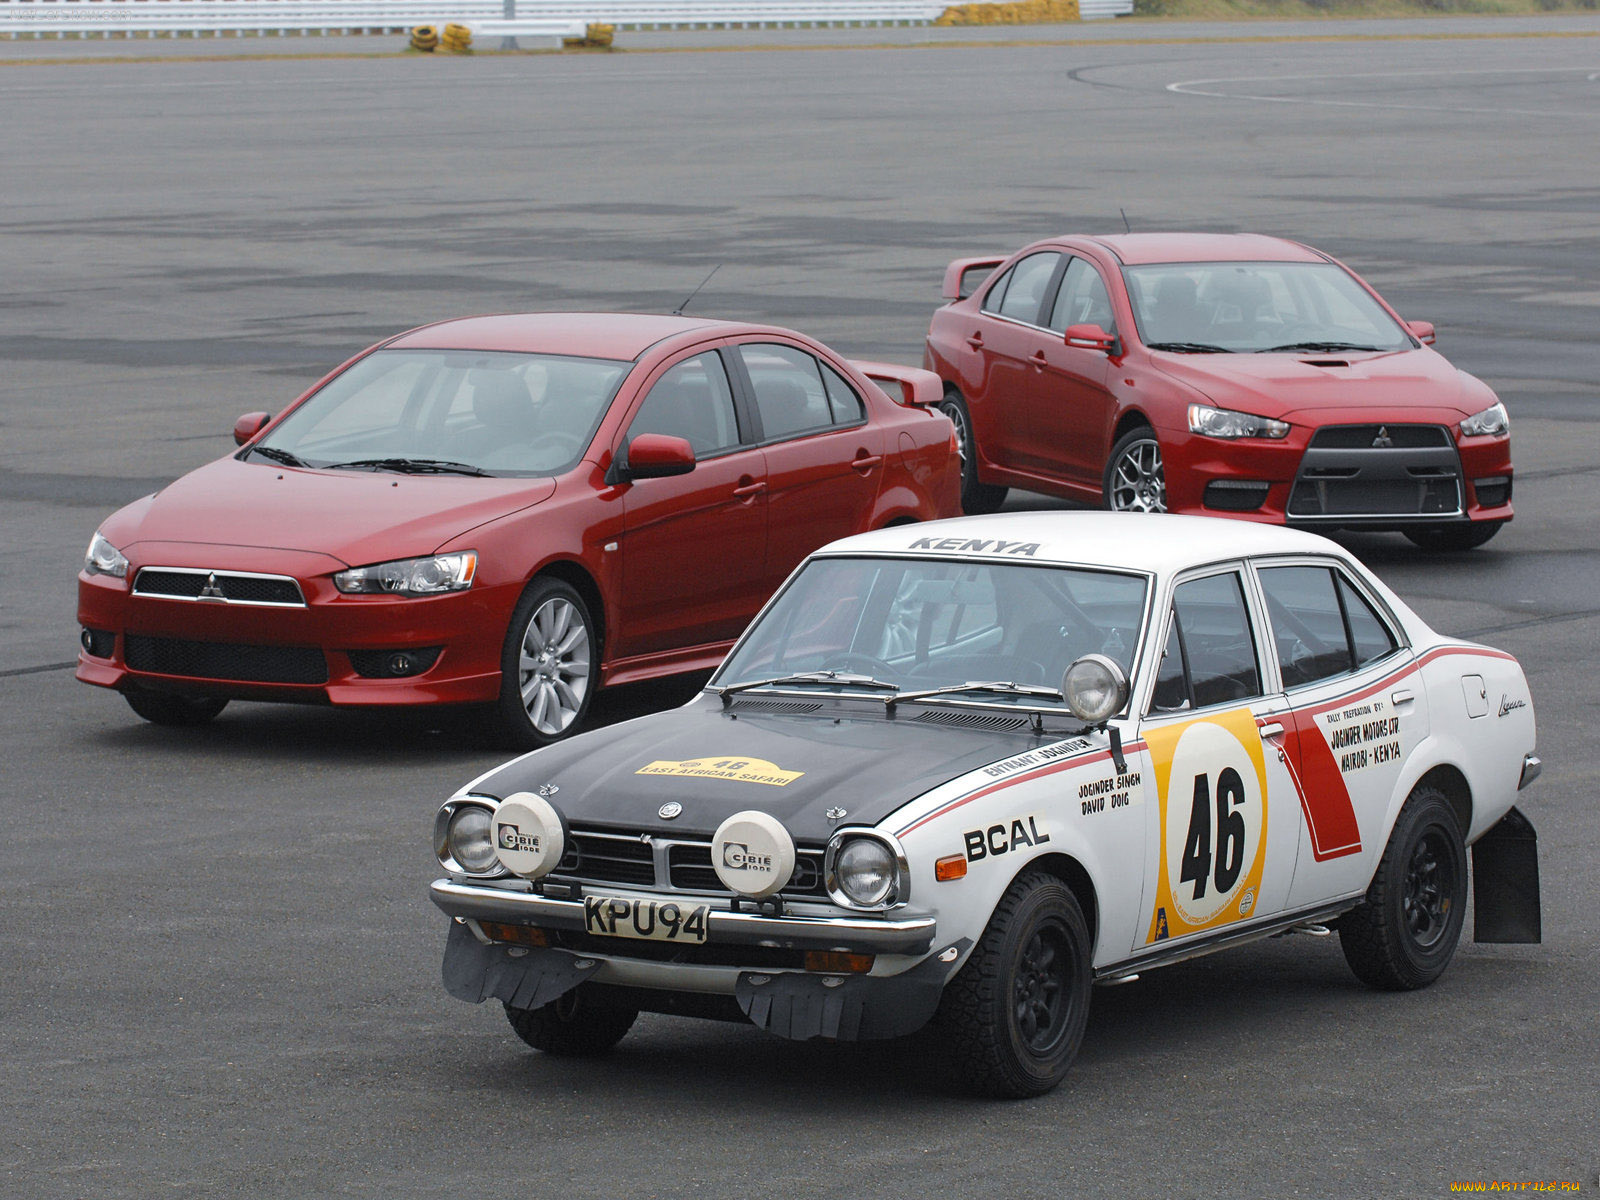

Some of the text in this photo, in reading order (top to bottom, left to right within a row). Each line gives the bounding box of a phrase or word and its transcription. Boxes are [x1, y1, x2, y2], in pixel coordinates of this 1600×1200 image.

[908, 537, 1041, 556] KENYA
[1331, 725, 1362, 750] JOGINDER
[1362, 719, 1388, 742] MOTORS
[1038, 738, 1093, 760] JOGINDER
[1341, 749, 1367, 773] NAIROBI
[1373, 741, 1401, 764] KENYA
[679, 768, 736, 778] AFRICAN
[738, 771, 790, 784] SAFARI
[713, 760, 750, 770] 46
[1078, 773, 1141, 799] JOGINDER SINGH
[1081, 792, 1129, 816] DAVID DOIG
[963, 816, 1050, 861] BCAL
[1180, 766, 1246, 901] 46
[585, 896, 707, 941] KPU94
